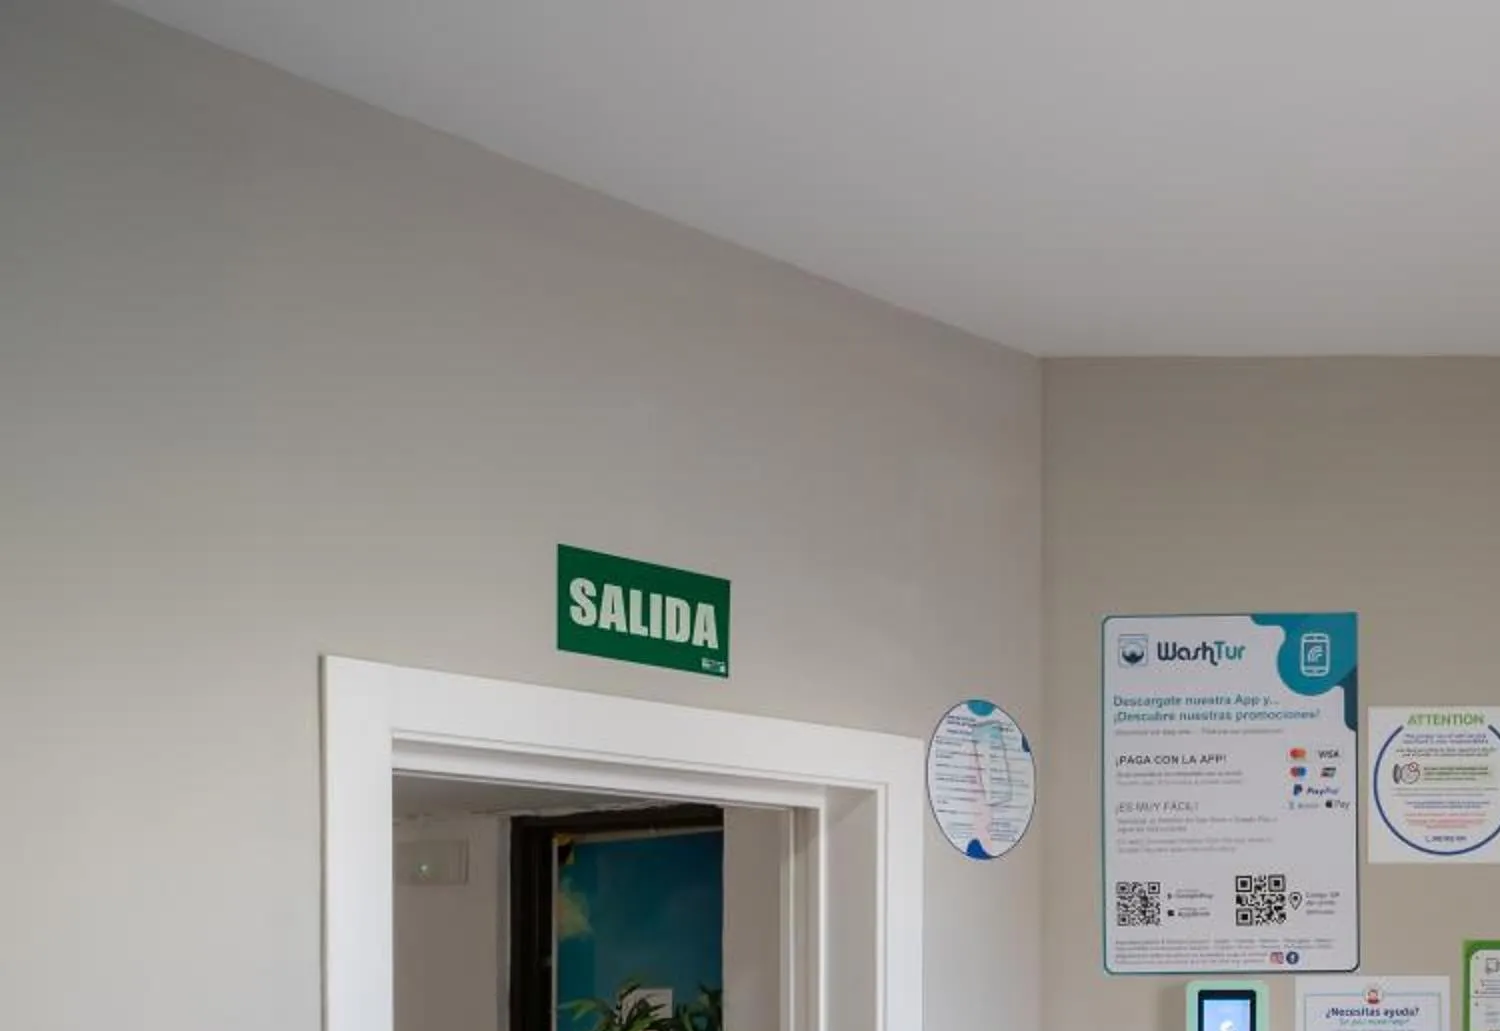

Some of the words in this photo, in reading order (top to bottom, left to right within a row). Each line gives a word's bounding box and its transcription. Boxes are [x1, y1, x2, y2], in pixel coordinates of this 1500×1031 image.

[569, 577, 719, 649] SALIDA
[1157, 641, 1246, 666] WashTur
[1186, 695, 1231, 705] nuestra
[1234, 694, 1259, 707] App
[1179, 711, 1232, 721] nuestras
[1235, 709, 1320, 722] promociones!
[1407, 713, 1486, 726] ATTENTION
[1116, 755, 1150, 767] ¡PAGA
[1154, 755, 1179, 765] CON
[1182, 755, 1197, 764] LA
[1200, 755, 1227, 765] APP!
[1325, 1007, 1381, 1019] ¿Necesitas
[1383, 1007, 1420, 1019] ayuda?
